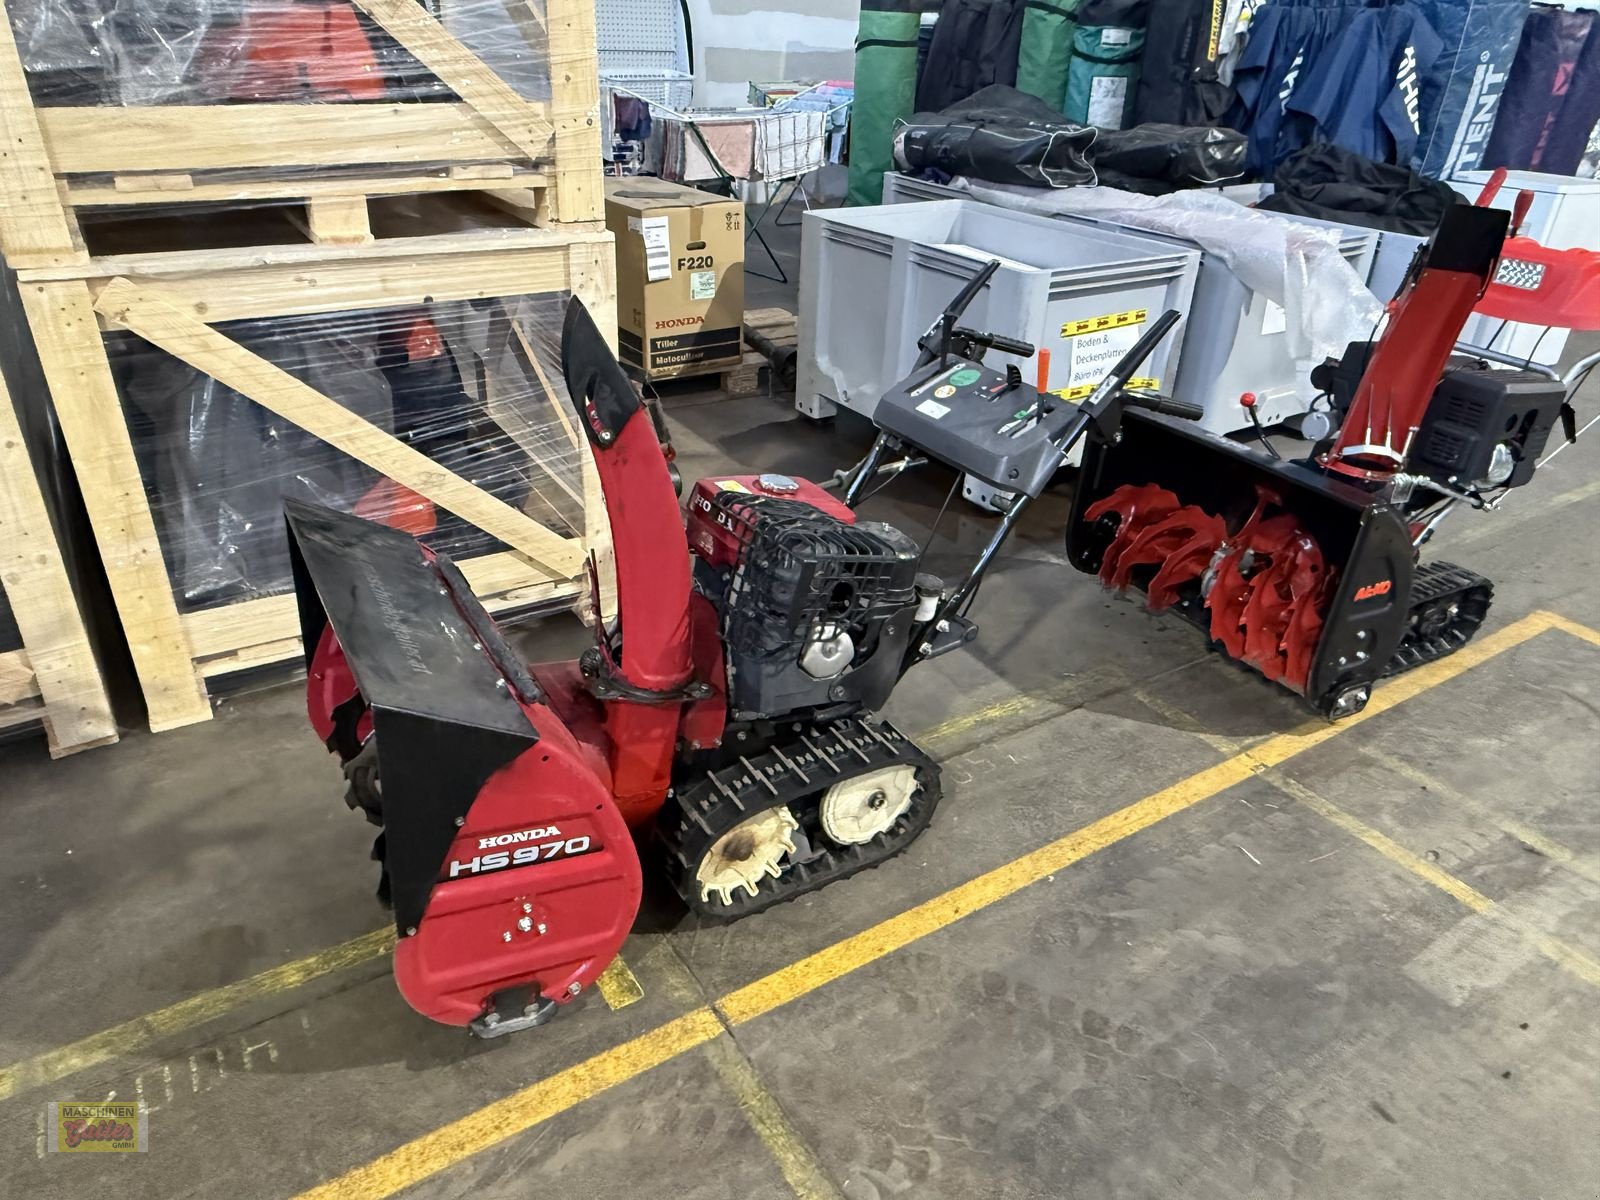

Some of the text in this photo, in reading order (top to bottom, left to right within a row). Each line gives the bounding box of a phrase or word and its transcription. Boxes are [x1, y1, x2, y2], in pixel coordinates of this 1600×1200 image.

[677, 256, 714, 271] F220
[656, 316, 705, 330] HONDA
[656, 340, 678, 349] Tiller
[1077, 334, 1109, 349] Boden &
[479, 826, 561, 850] HONDA
[450, 836, 590, 877] HS970
